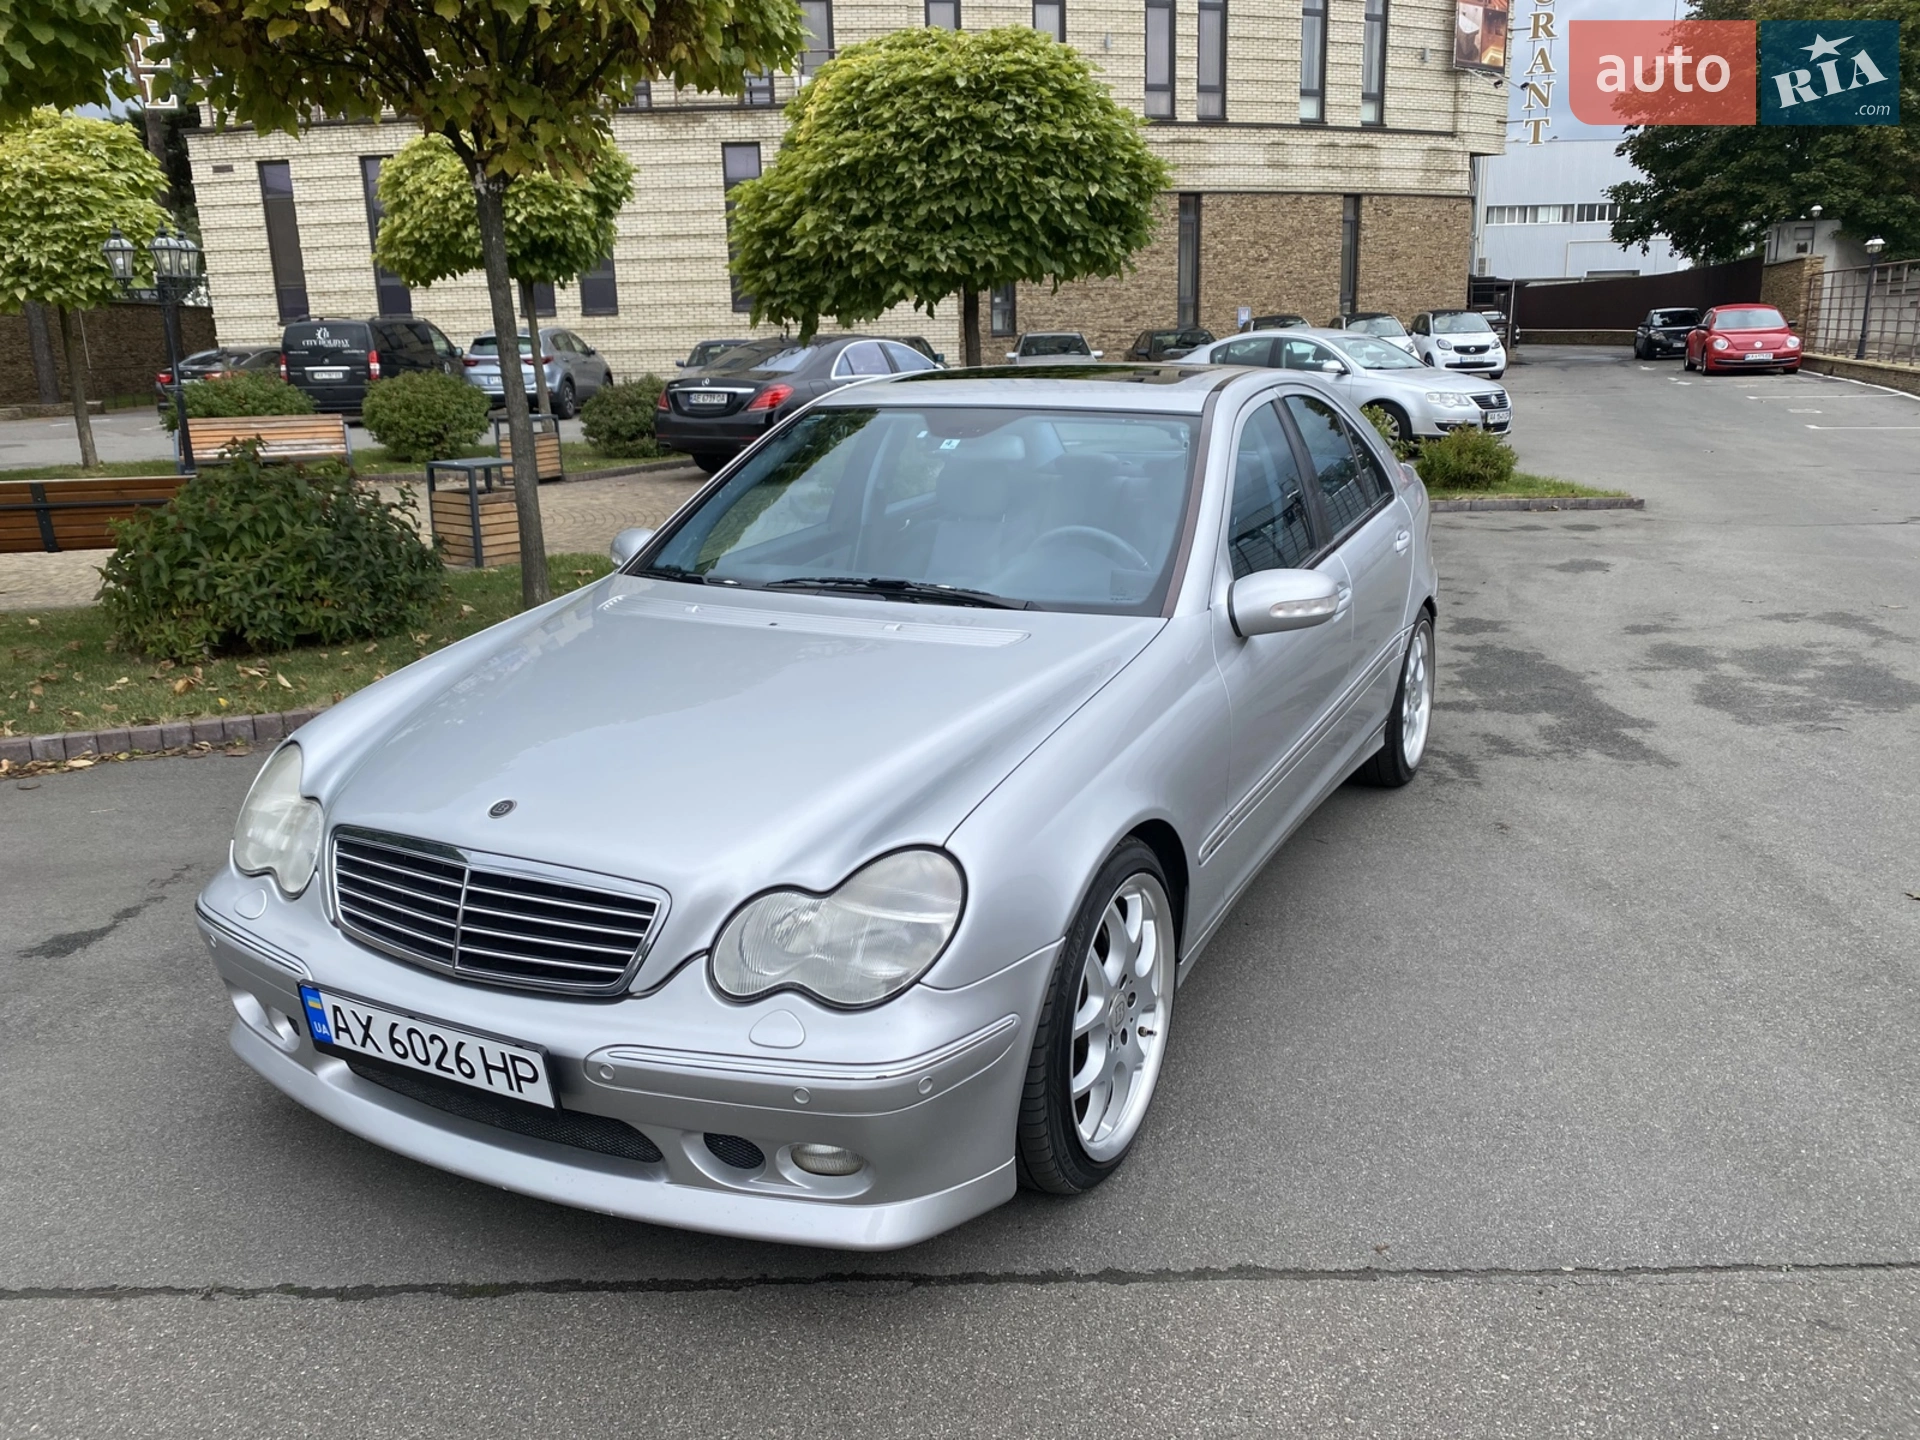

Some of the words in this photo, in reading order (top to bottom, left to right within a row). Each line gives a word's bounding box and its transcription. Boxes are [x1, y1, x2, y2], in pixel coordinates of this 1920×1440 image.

[1523, 0, 1558, 146] RANT
[313, 1022, 331, 1037] UA
[331, 1003, 384, 1055] AX
[388, 1022, 476, 1080] 6026
[478, 1045, 540, 1095] HP
